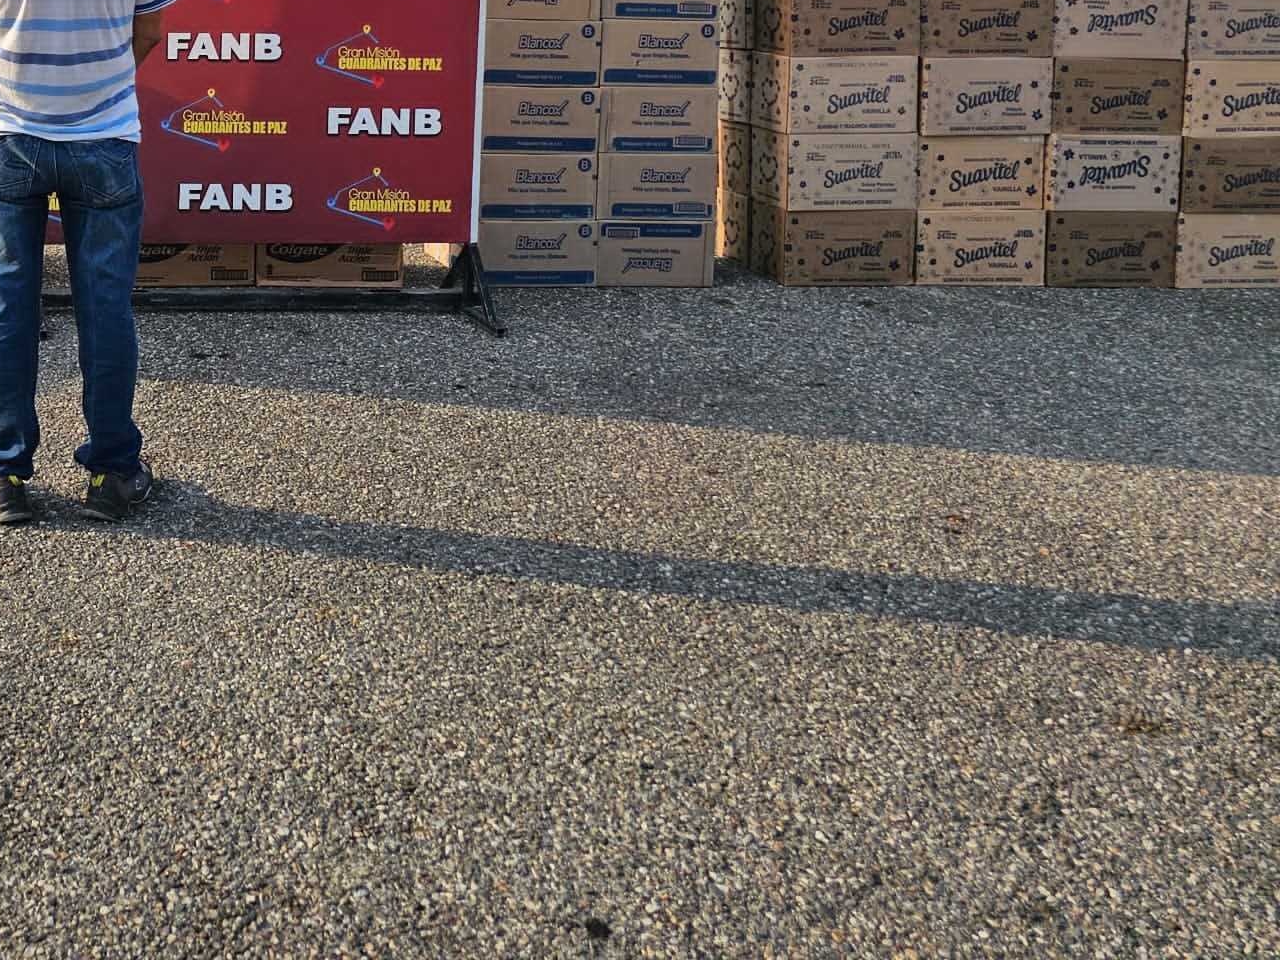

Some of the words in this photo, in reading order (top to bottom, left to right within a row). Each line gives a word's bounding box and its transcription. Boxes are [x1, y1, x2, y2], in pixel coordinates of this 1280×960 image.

[167, 32, 283, 62] FANB
[519, 33, 570, 49] Blancox
[639, 33, 690, 49] Blancox
[337, 46, 365, 58] Gran
[367, 46, 400, 58] Misión
[338, 57, 406, 70] CUADRANTES
[407, 58, 421, 70] DE
[423, 58, 442, 71] PAZ
[183, 110, 209, 122] Gran
[211, 110, 245, 123] Misión
[519, 100, 569, 117] Blancox
[640, 100, 691, 117] Blancox
[183, 121, 251, 134] CUADRANTES
[253, 122, 266, 134] DE
[268, 122, 287, 134] PAZ
[327, 107, 443, 137] FANB
[515, 168, 567, 184] Blancox
[640, 167, 691, 184] Blancox
[177, 183, 293, 213] FANB
[348, 188, 375, 200] Gran
[377, 188, 410, 200] Misión
[348, 199, 416, 212] CUADRANTES
[417, 200, 431, 212] DE
[432, 200, 452, 212] PAZ
[515, 234, 567, 250] Blancox
